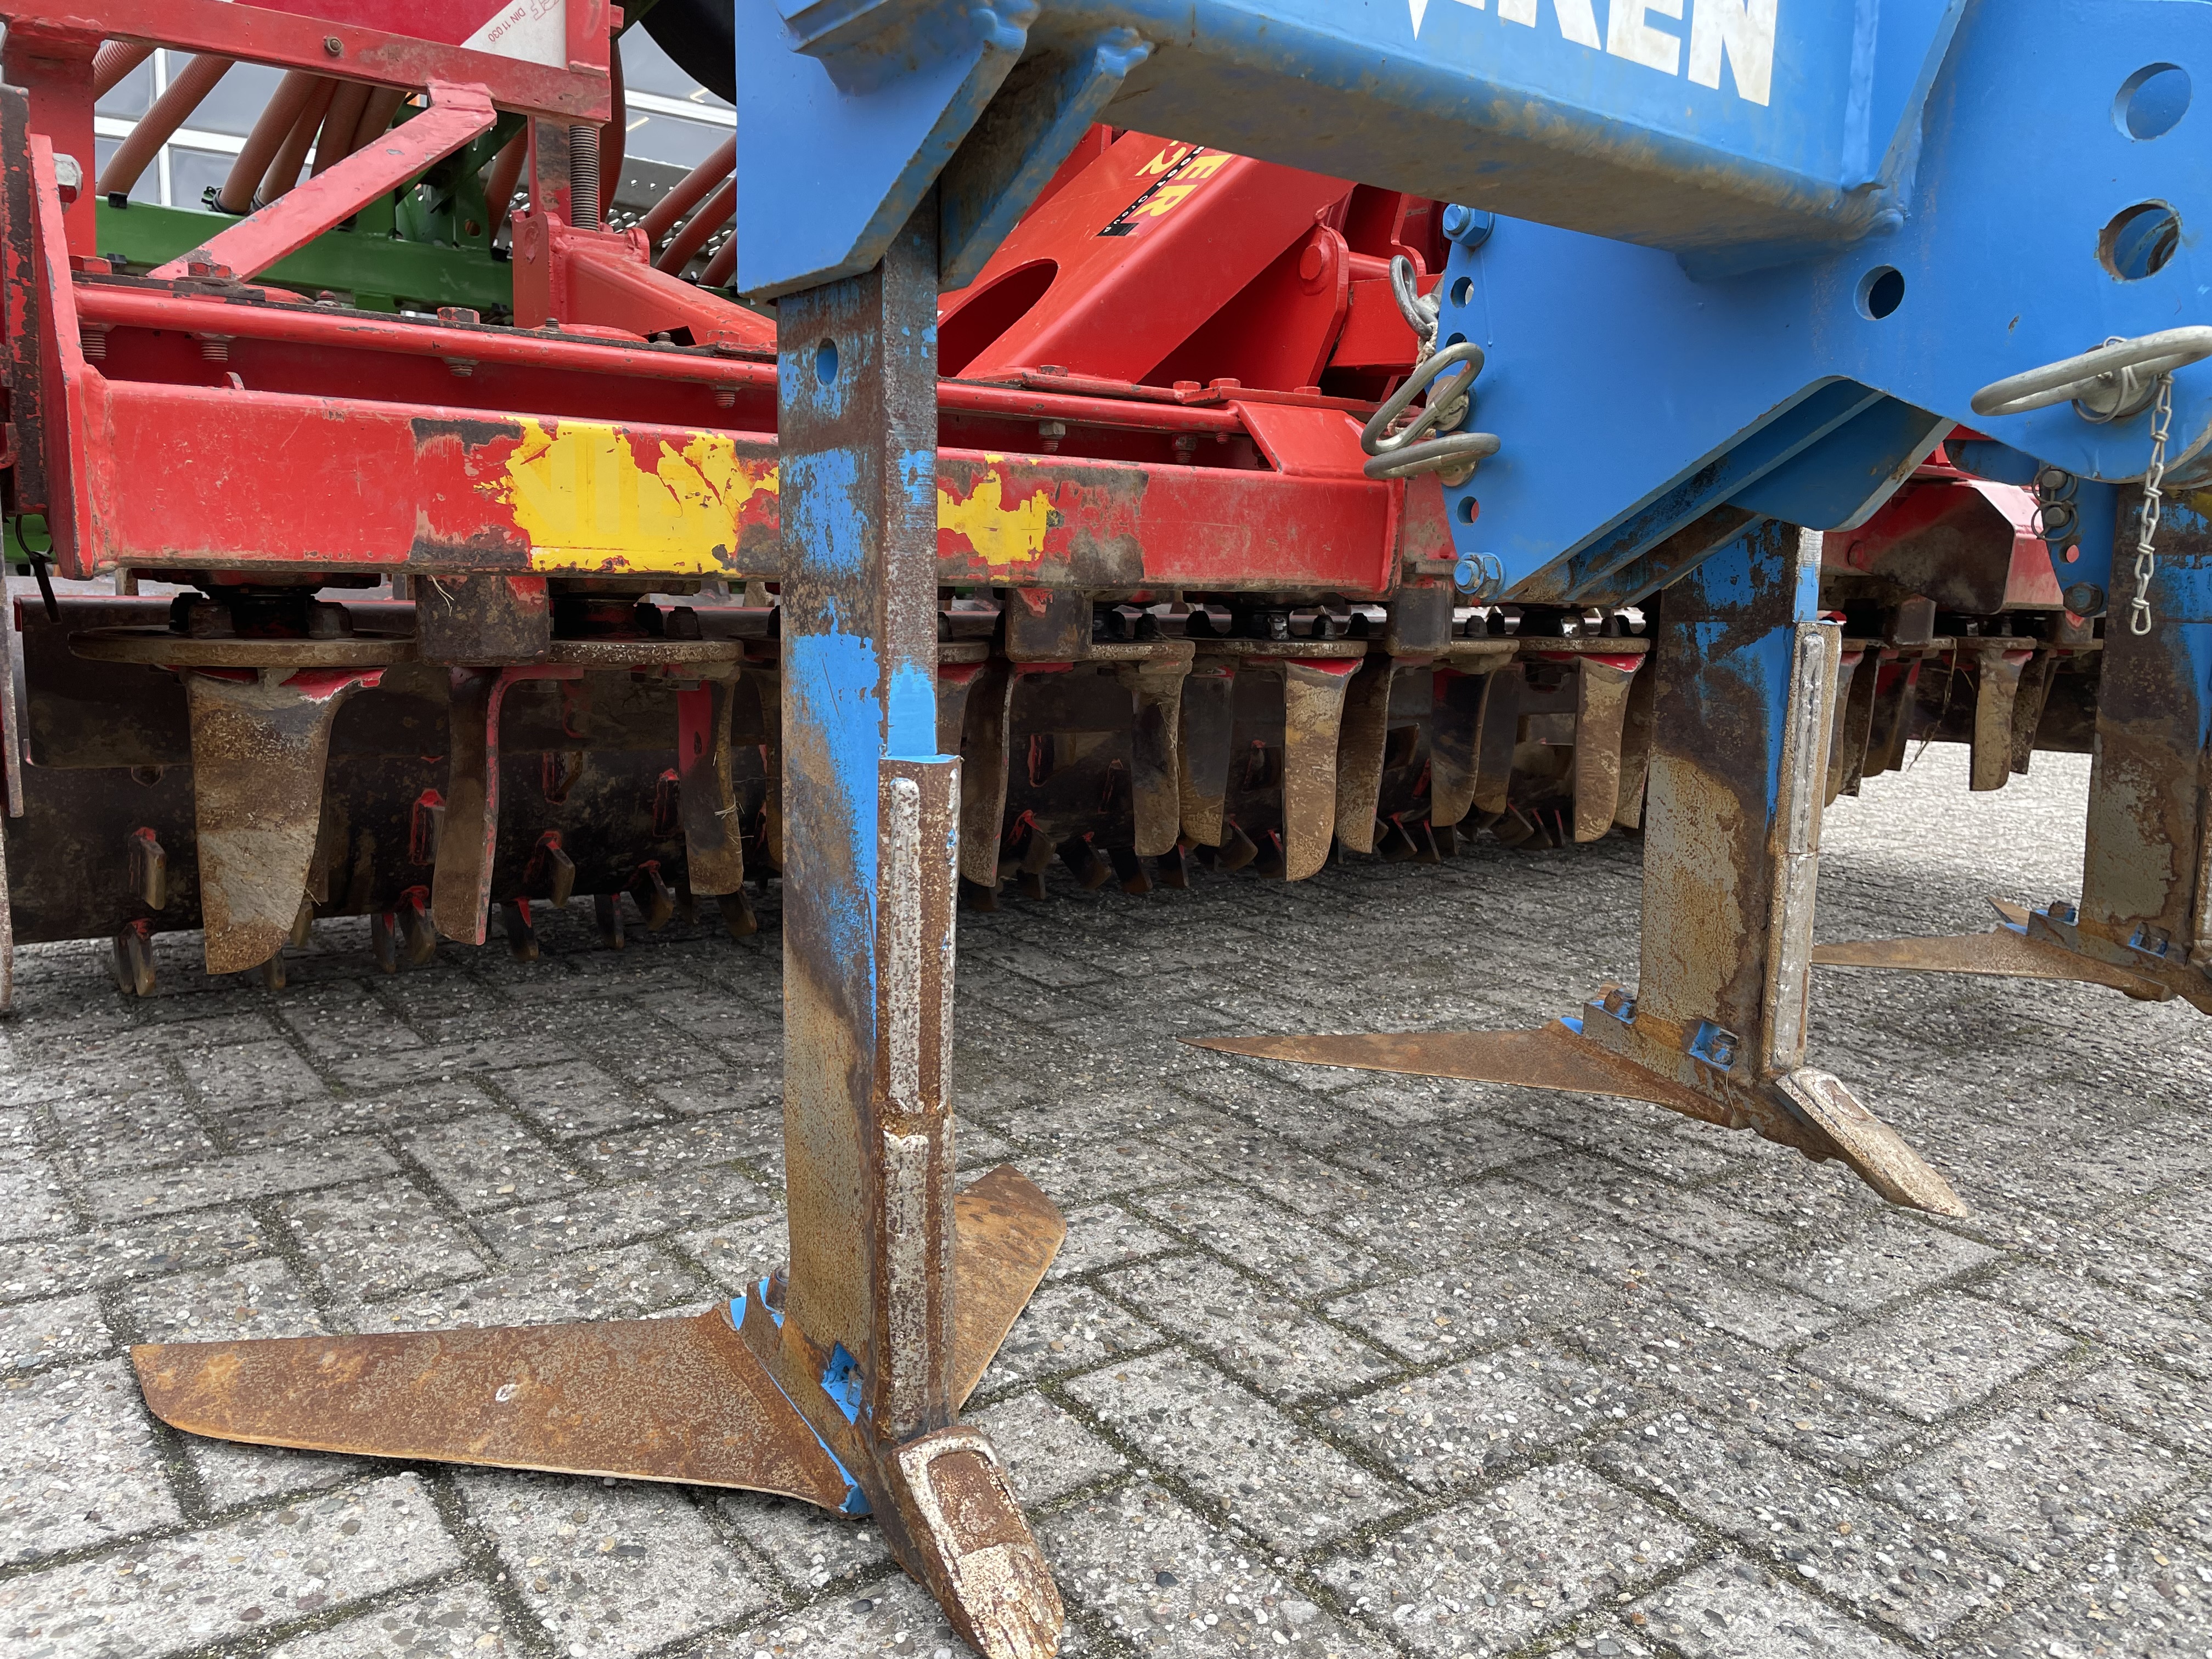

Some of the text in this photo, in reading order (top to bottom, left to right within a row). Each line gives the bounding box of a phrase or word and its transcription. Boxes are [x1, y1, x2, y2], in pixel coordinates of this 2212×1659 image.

[510, 7, 526, 24] DIN
[501, 20, 511, 30] 11
[488, 26, 503, 42] 030
